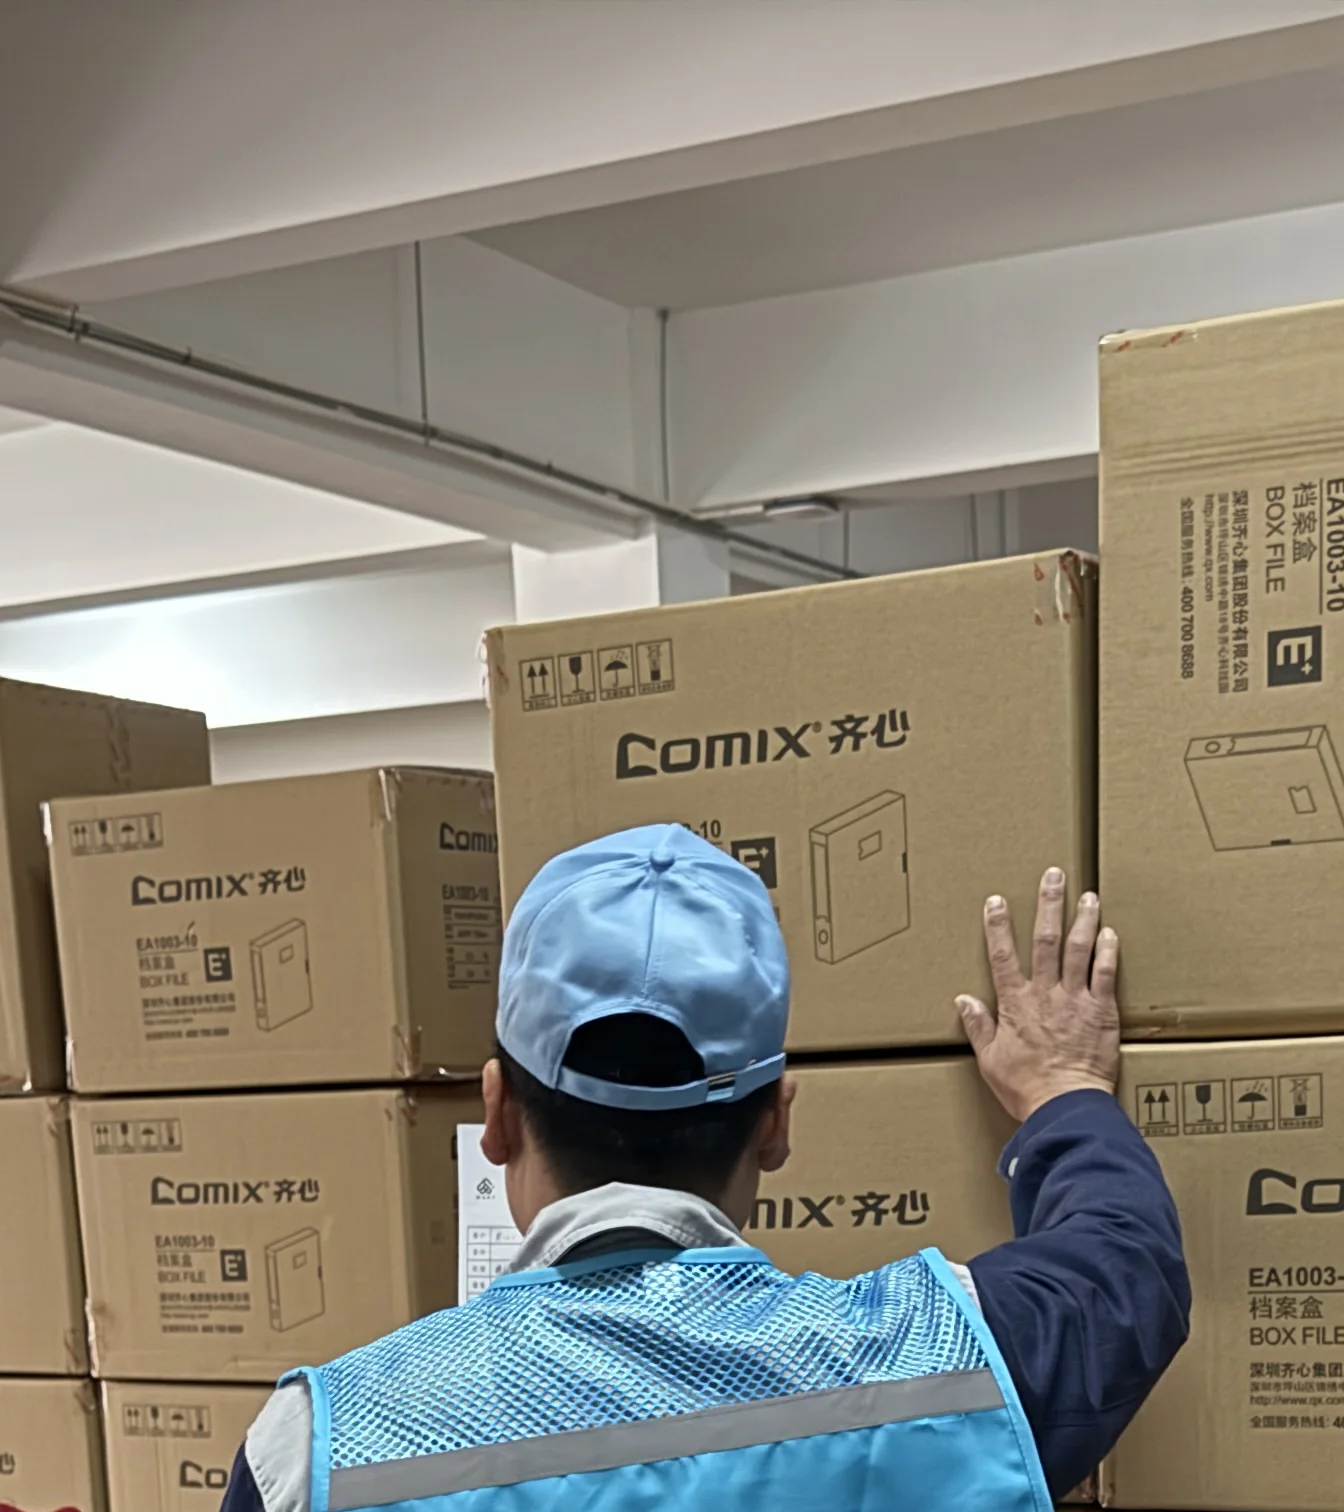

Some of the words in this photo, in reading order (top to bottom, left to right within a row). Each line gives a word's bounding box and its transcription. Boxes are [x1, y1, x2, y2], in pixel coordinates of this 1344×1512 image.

[1265, 486, 1286, 538] BOX
[1291, 482, 1318, 564] 档案盒
[1265, 543, 1286, 594] FILE
[1180, 585, 1195, 612] 400
[1180, 615, 1195, 642] 700
[828, 707, 911, 756] 齐心
[258, 866, 307, 894] 齐心
[274, 1176, 320, 1203] 齐心
[851, 1189, 930, 1228] 齐心
[1249, 1295, 1324, 1320] 档案盒
[1250, 1327, 1297, 1345] BOX
